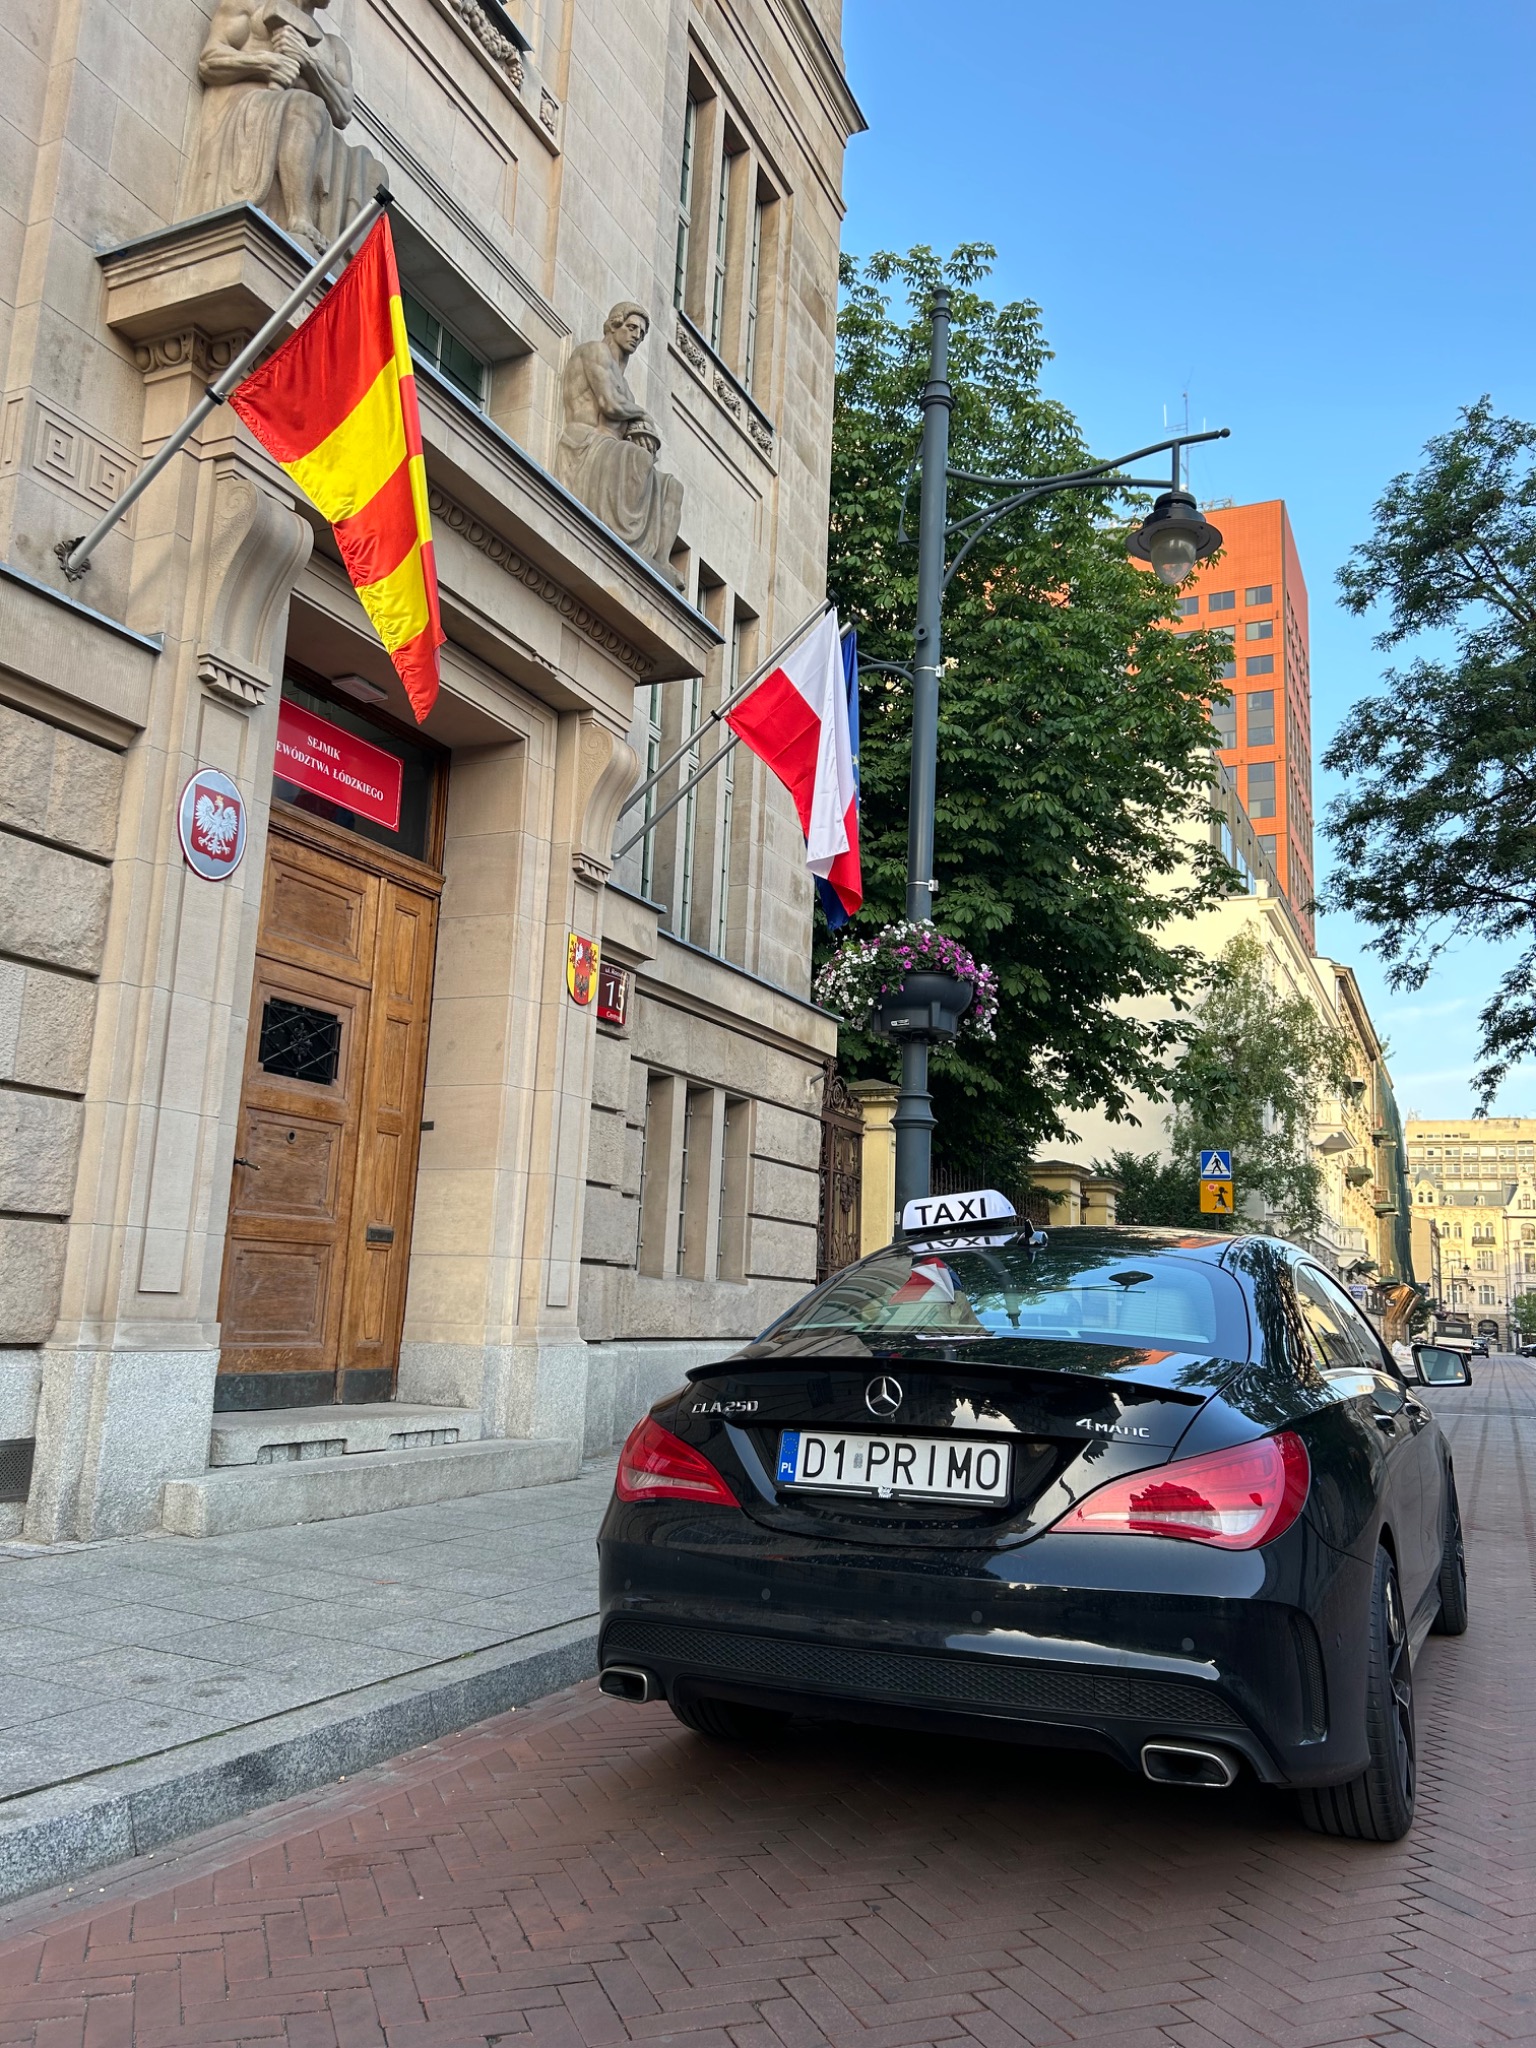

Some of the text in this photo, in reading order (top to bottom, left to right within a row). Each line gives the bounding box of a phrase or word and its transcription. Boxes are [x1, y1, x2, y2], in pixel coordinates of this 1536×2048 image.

[307, 735, 341, 760] SEJMIK
[333, 769, 384, 801] ŁÓDZKIEGO
[606, 981, 625, 1010] 15
[914, 1198, 987, 1225] TAXI
[691, 1400, 759, 1414] CLA 250
[1076, 1418, 1150, 1438] 4MATIC
[781, 1462, 794, 1474] PL
[802, 1438, 1001, 1490] D1 PRIMO
